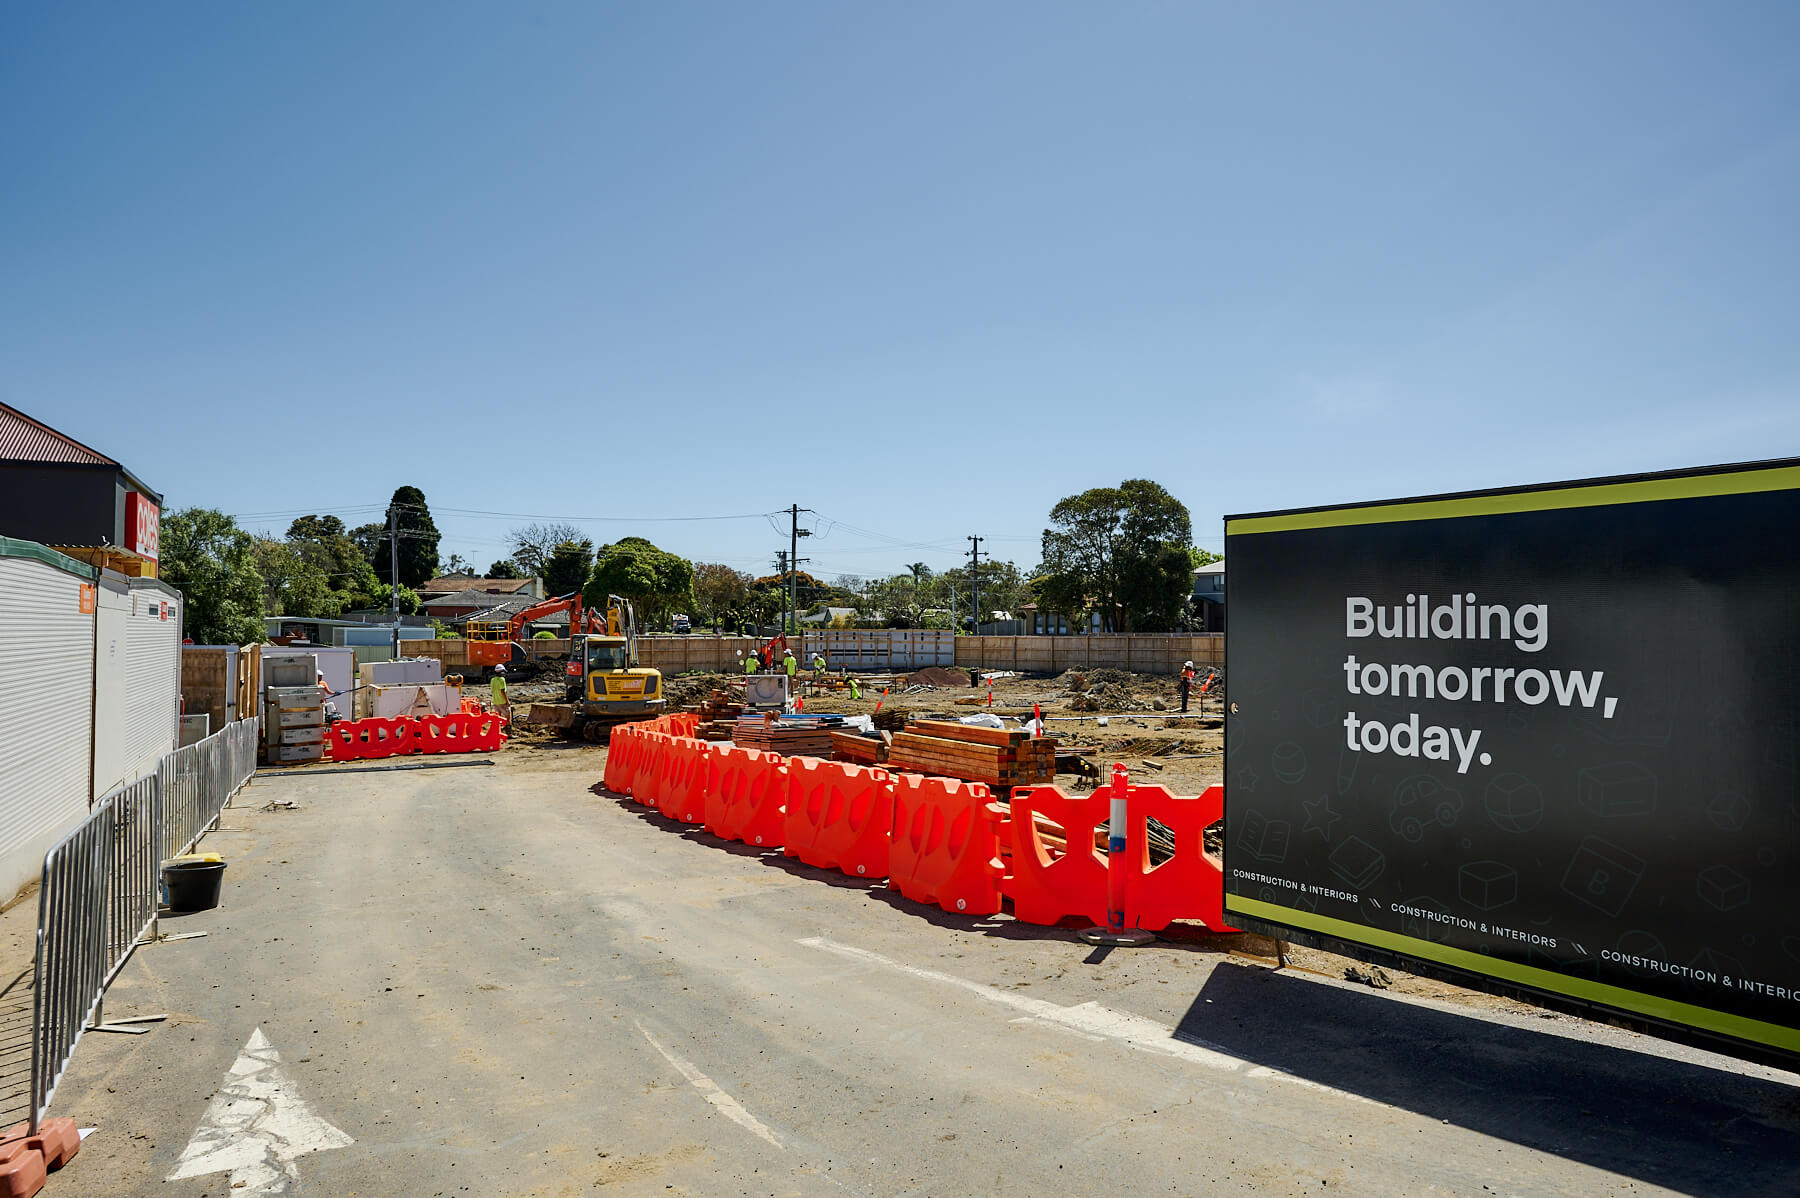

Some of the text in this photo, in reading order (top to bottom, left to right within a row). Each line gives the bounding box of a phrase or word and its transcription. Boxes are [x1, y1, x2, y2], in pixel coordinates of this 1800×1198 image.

[137, 500, 158, 551] coles
[1346, 592, 1548, 653] Building
[1343, 654, 1619, 719] tomorrow,
[1343, 711, 1492, 775] today.
[1233, 868, 1359, 903] CONSTRUCTION & INTERIORS
[1391, 903, 1557, 949] CONSTRUCTION & INTERIORS
[1601, 949, 1717, 984] CONSTRUCTION
[1722, 975, 1733, 987] &
